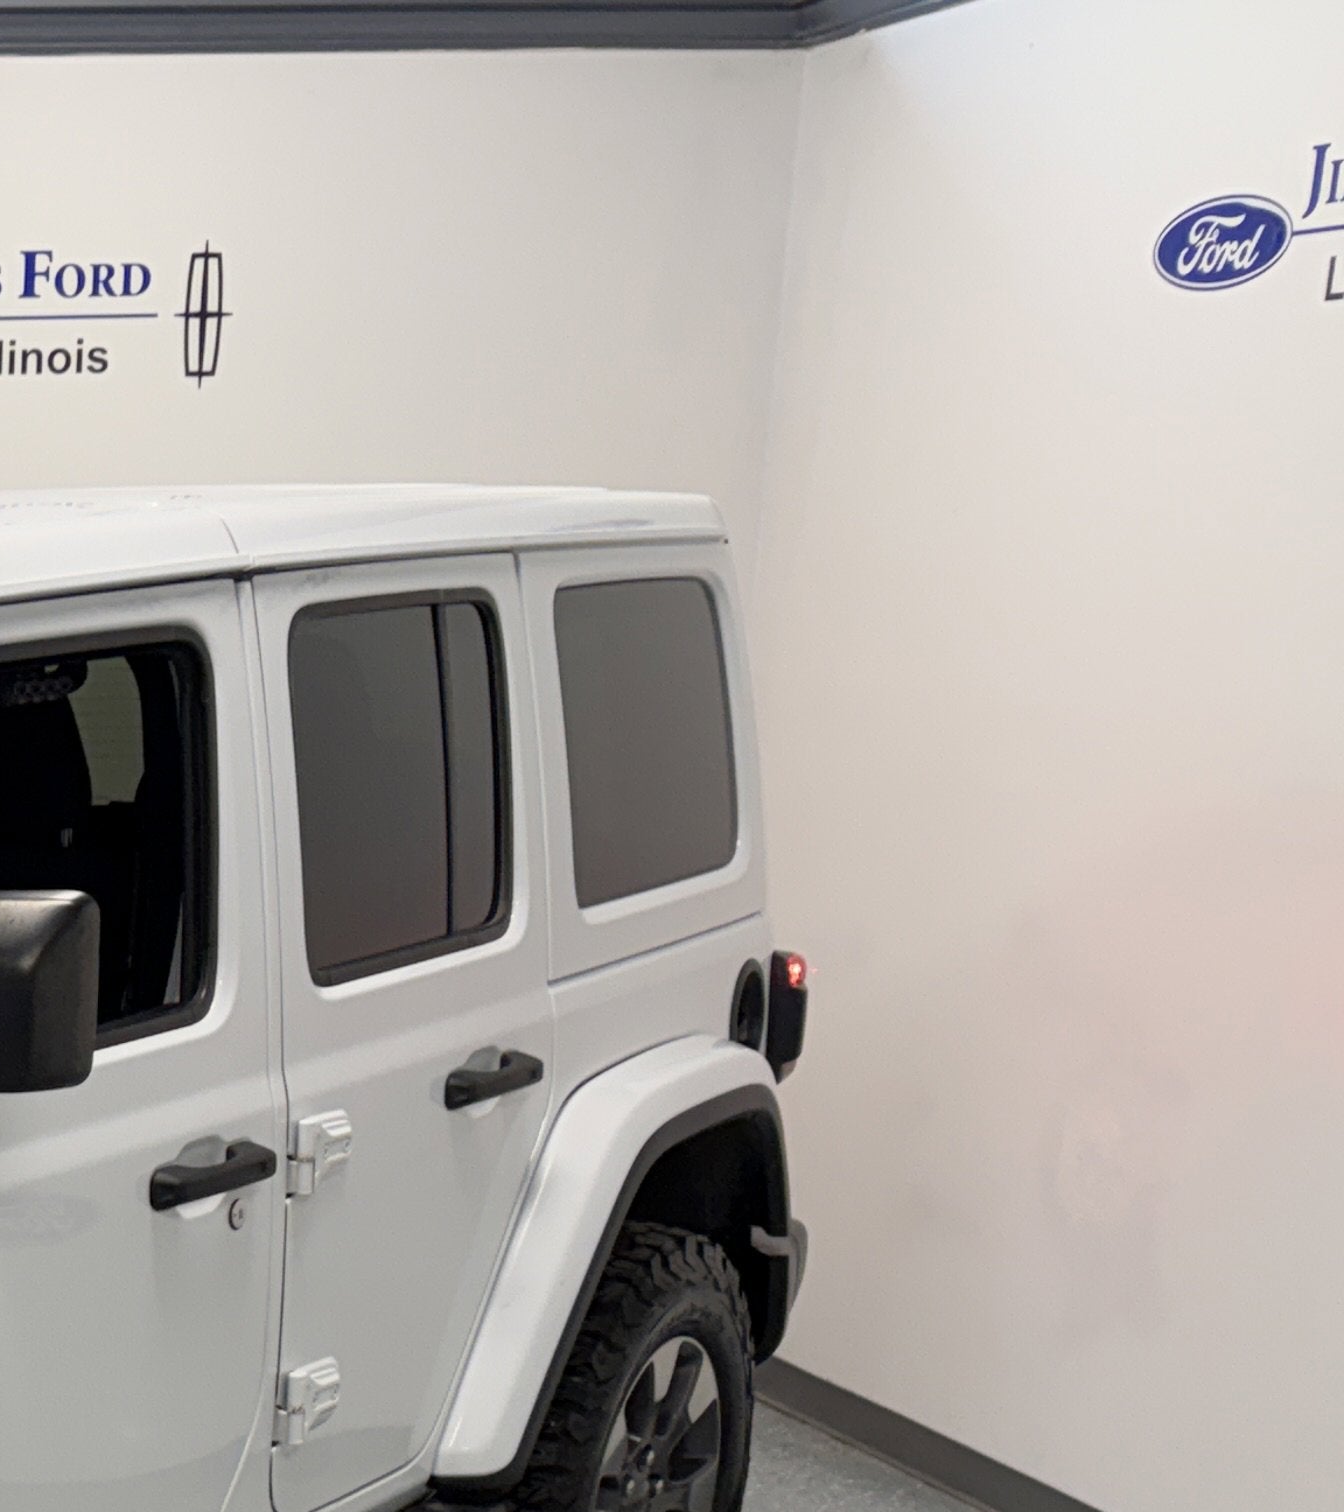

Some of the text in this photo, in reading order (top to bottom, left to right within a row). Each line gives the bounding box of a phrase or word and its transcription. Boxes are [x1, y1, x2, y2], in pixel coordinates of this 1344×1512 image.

[1302, 143, 1344, 219] JI
[18, 250, 152, 299] FORD
[1177, 213, 1266, 276] Ford
